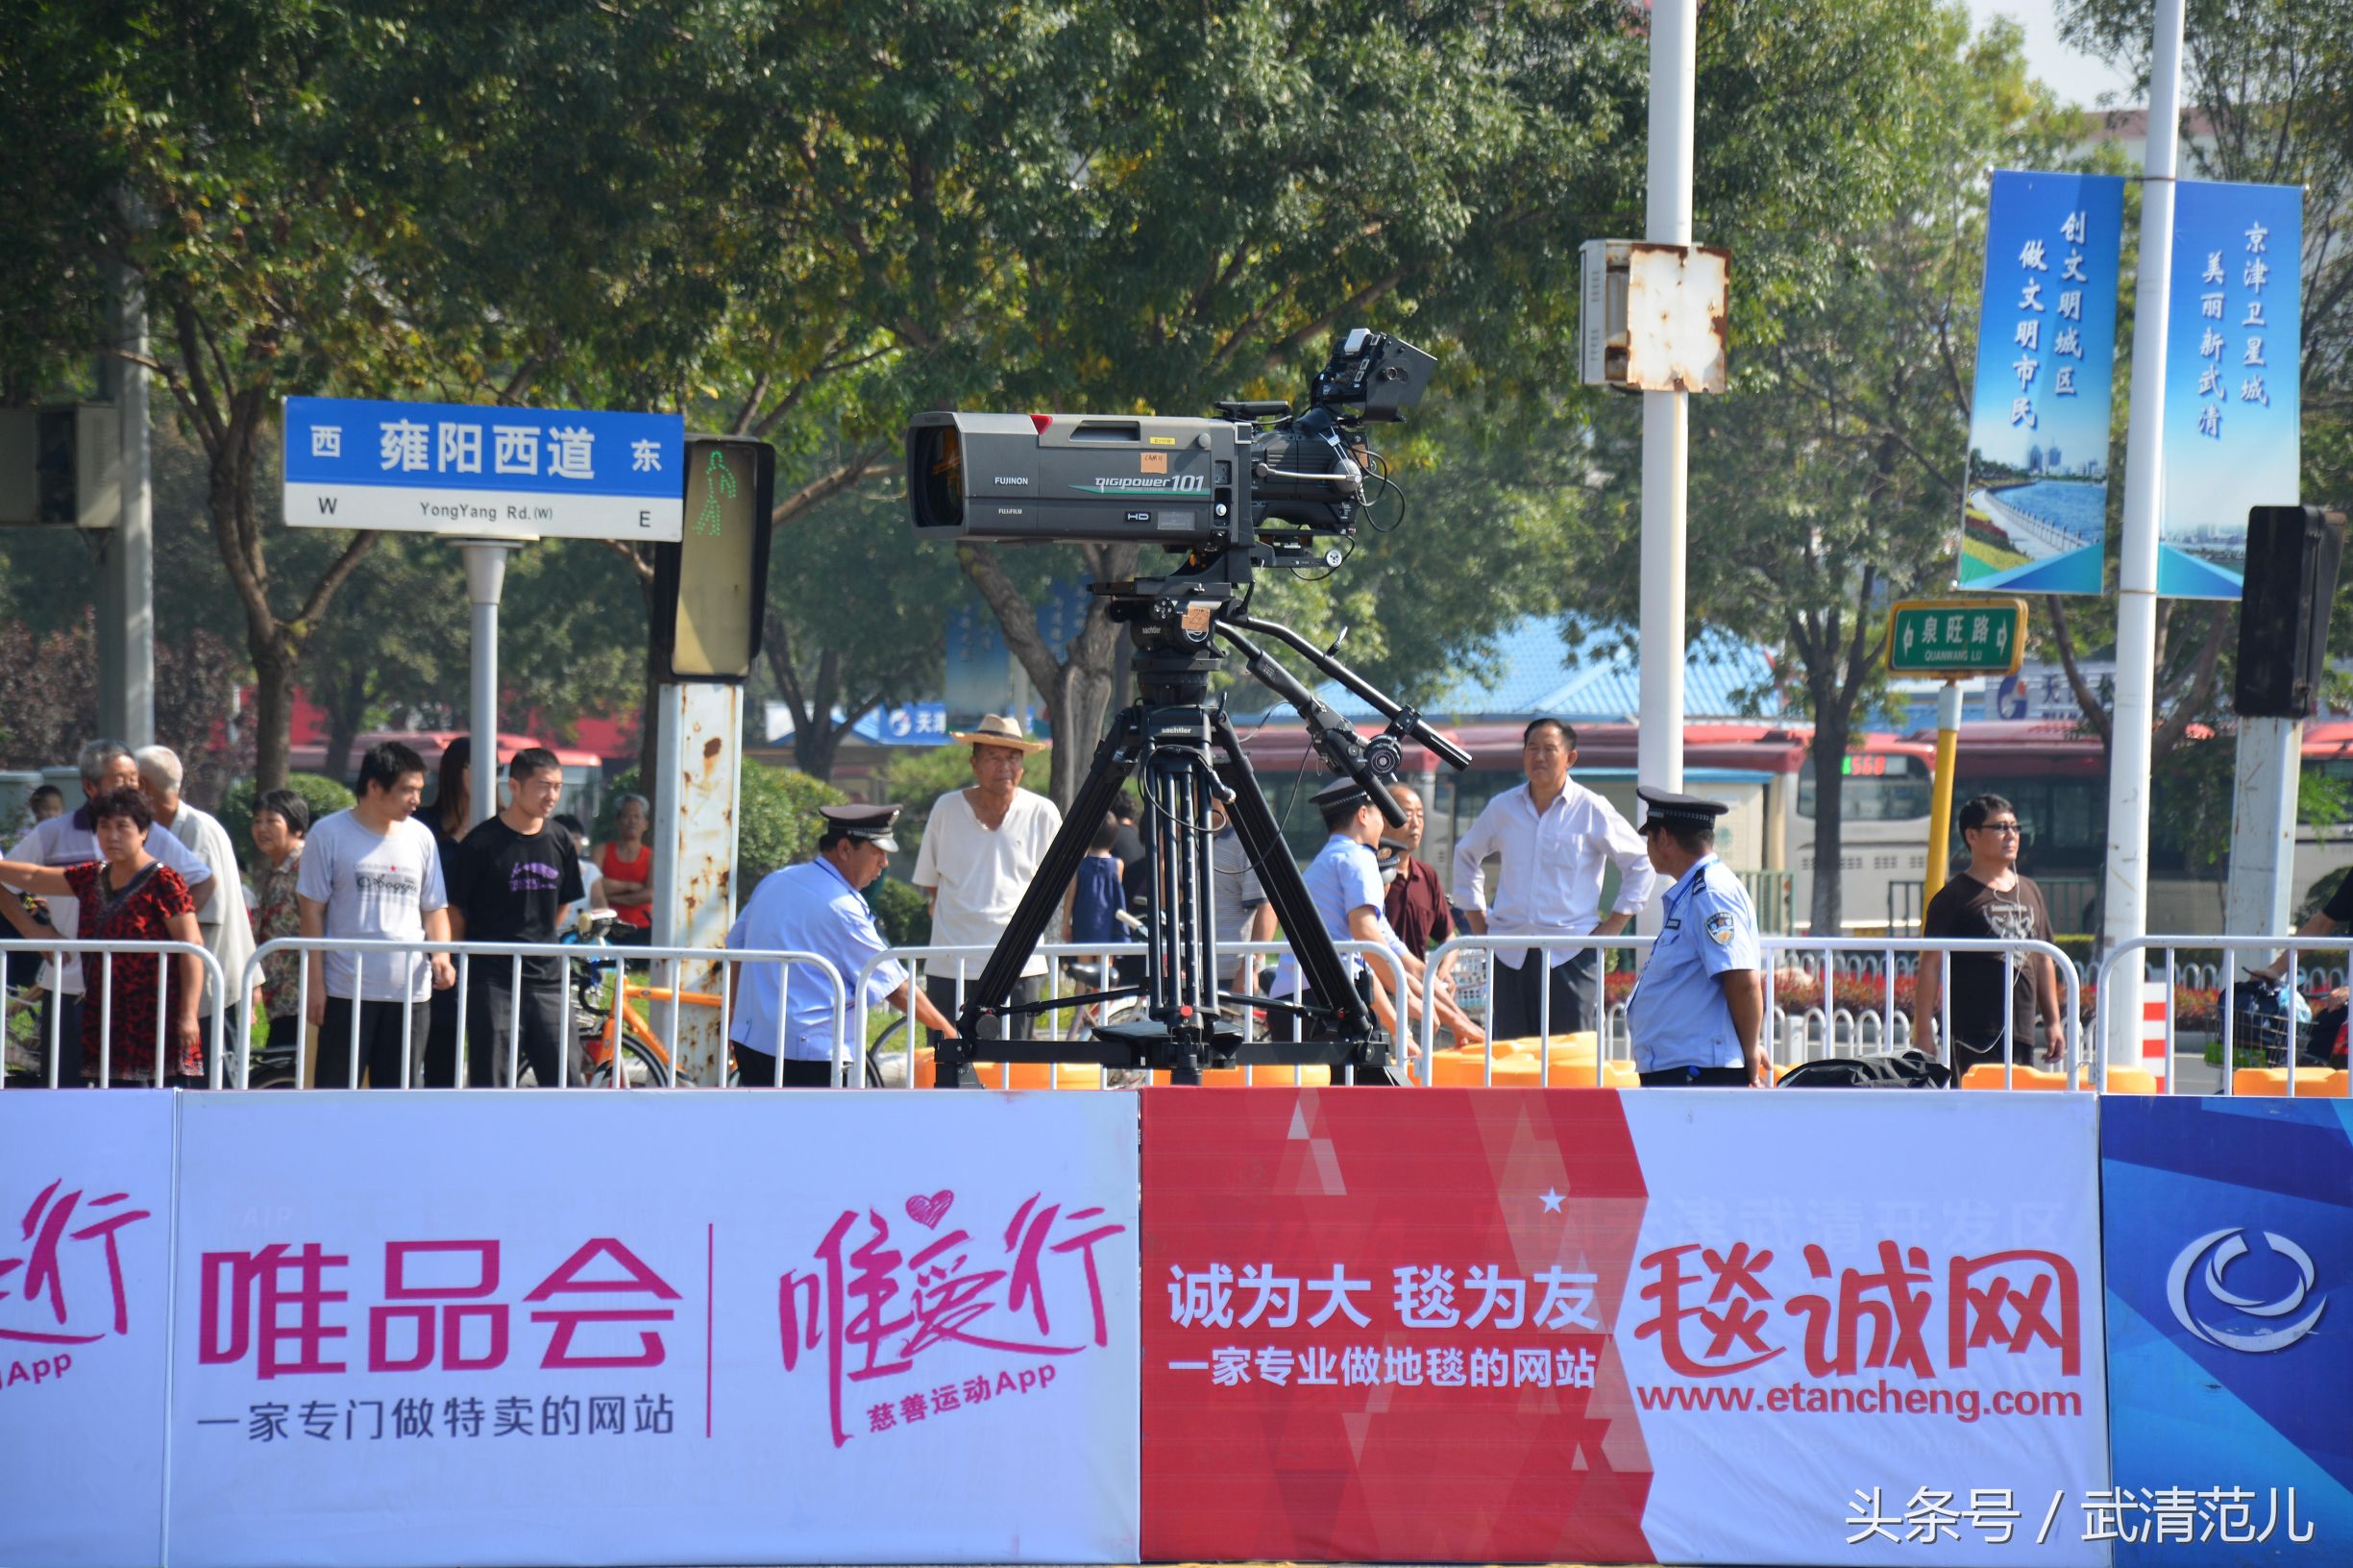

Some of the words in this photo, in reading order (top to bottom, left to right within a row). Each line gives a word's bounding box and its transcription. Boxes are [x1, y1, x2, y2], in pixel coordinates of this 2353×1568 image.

[2054, 210, 2089, 396] 创文明城区
[2240, 221, 2269, 407] 京津卫星城
[2010, 238, 2048, 429] 做文明市民
[2198, 251, 2226, 438] 美丽新武清
[310, 425, 342, 457] 西
[380, 418, 596, 478] 雍阳西道
[631, 439, 662, 472] 东
[994, 477, 1028, 485] FUJINON
[1171, 475, 1204, 492] 101
[318, 499, 337, 514] W
[420, 502, 498, 522] YongYang
[639, 511, 650, 527] E
[1922, 614, 1990, 644] 泉旺路
[1924, 649, 1968, 661] QUANWANG
[1971, 650, 1983, 661] LU
[0, 1178, 151, 1344] 行
[198, 1237, 684, 1381] 唯品会
[778, 1191, 1126, 1448] 唯爱行
[1167, 1262, 1372, 1330] 诚为大
[1392, 1264, 1599, 1331] 毯为友
[1634, 1239, 2081, 1380] 毯诚网
[0, 1353, 72, 1390] App
[1168, 1345, 1596, 1388] 一家专业做地毯的网站
[197, 1393, 674, 1441] 一家专门做特卖的网站
[1636, 1380, 2082, 1424] www.etancheng.com
